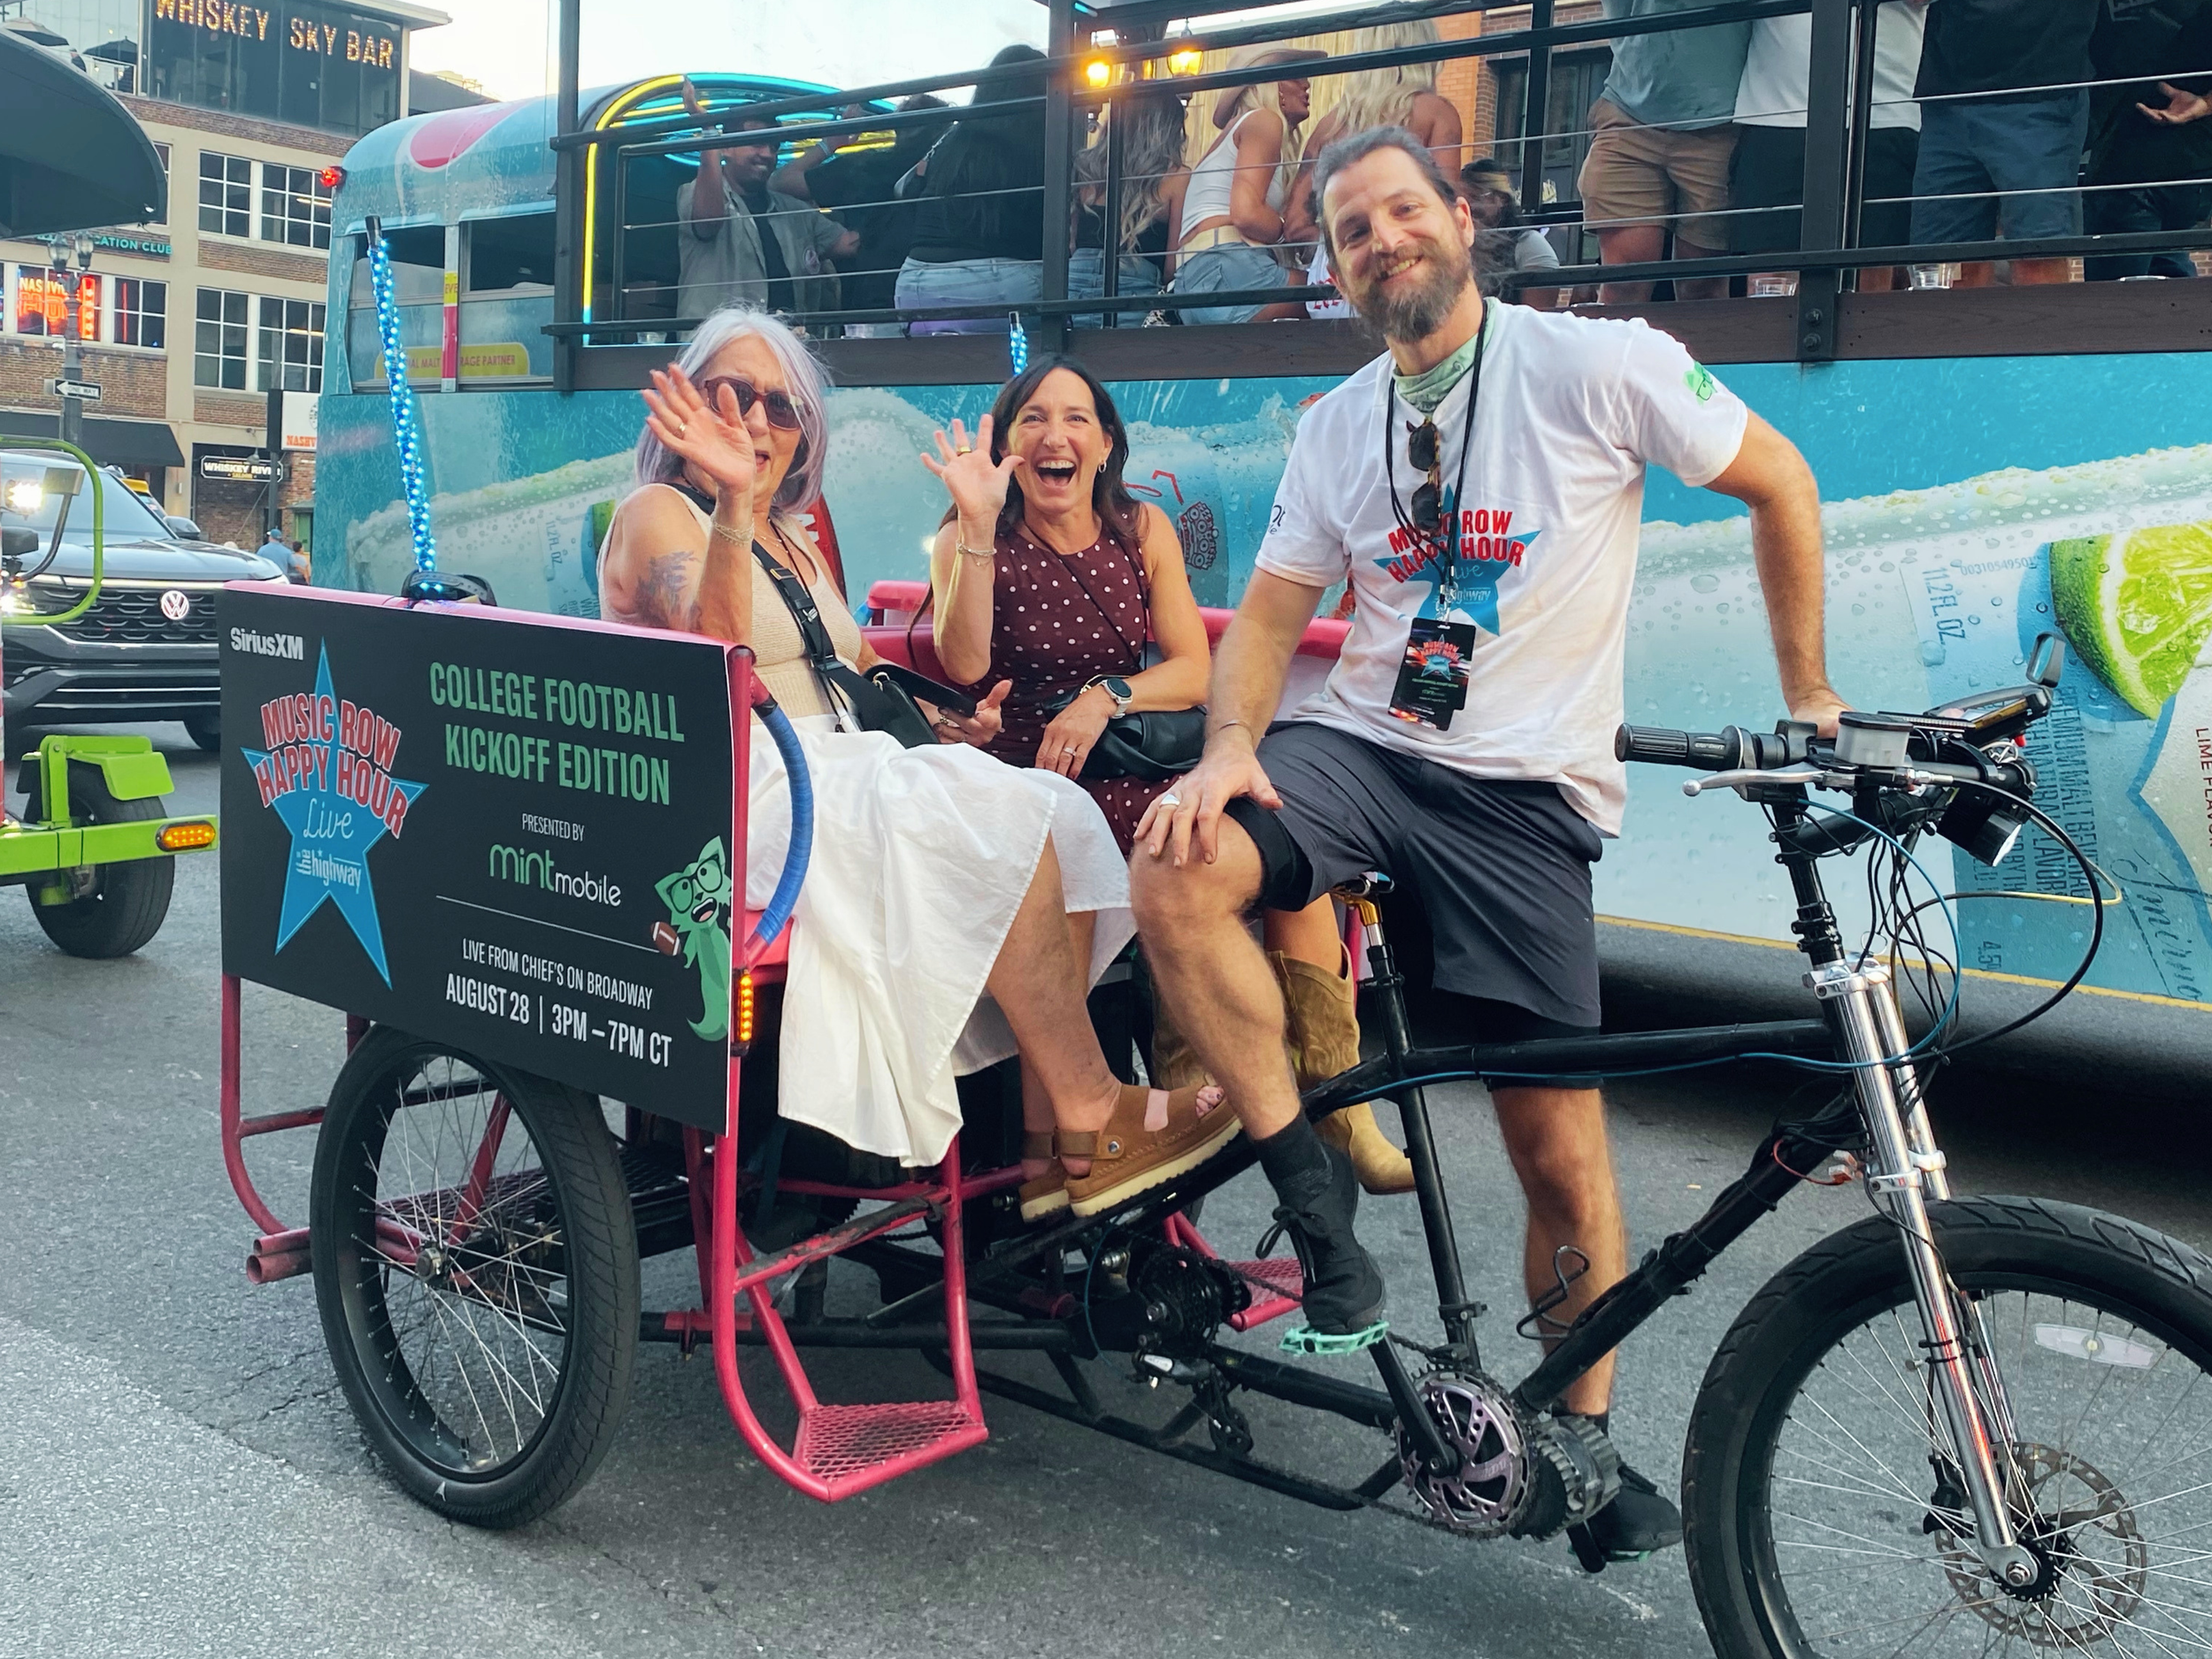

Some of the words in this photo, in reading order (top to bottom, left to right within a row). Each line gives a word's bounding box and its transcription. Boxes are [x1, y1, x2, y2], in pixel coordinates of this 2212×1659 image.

[156, 0, 269, 41] WHISKEY
[290, 18, 337, 55] SKY
[346, 30, 394, 69] BAR
[142, 243, 173, 256] CLUB
[482, 355, 515, 366] PARTNER
[68, 386, 81, 395] ONE
[83, 388, 97, 397] WAY
[204, 461, 250, 473] WHISKEY
[1462, 509, 1513, 535] ROW
[1459, 537, 1525, 567] HOUR
[231, 626, 303, 660] SiriusXM
[429, 662, 537, 719] COLLEGE
[544, 677, 685, 742] FOOTBALL
[260, 693, 334, 751] MUSIC
[340, 700, 402, 772] ROW
[2195, 726, 2212, 770] LIME
[445, 725, 550, 783] KICKOFF
[558, 741, 671, 806] EDITION
[254, 746, 329, 809] HAPPY
[337, 751, 409, 839] HOUR
[2059, 769, 2095, 818] MALT
[303, 797, 354, 839] Live
[522, 813, 570, 840] PRESENTED
[572, 823, 585, 842] BY
[296, 849, 312, 876] the
[311, 849, 362, 895] highway
[463, 938, 486, 964] LIVE
[488, 944, 518, 973] FROM
[521, 951, 565, 987] CHIEF'S
[566, 965, 584, 992] ON
[588, 972, 653, 1010] BROADWAY
[446, 973, 505, 1017] AUGUST
[510, 992, 530, 1025] 28
[551, 1005, 588, 1041] 3PM
[607, 1020, 643, 1058] 7PM
[649, 1034, 672, 1068] CT
